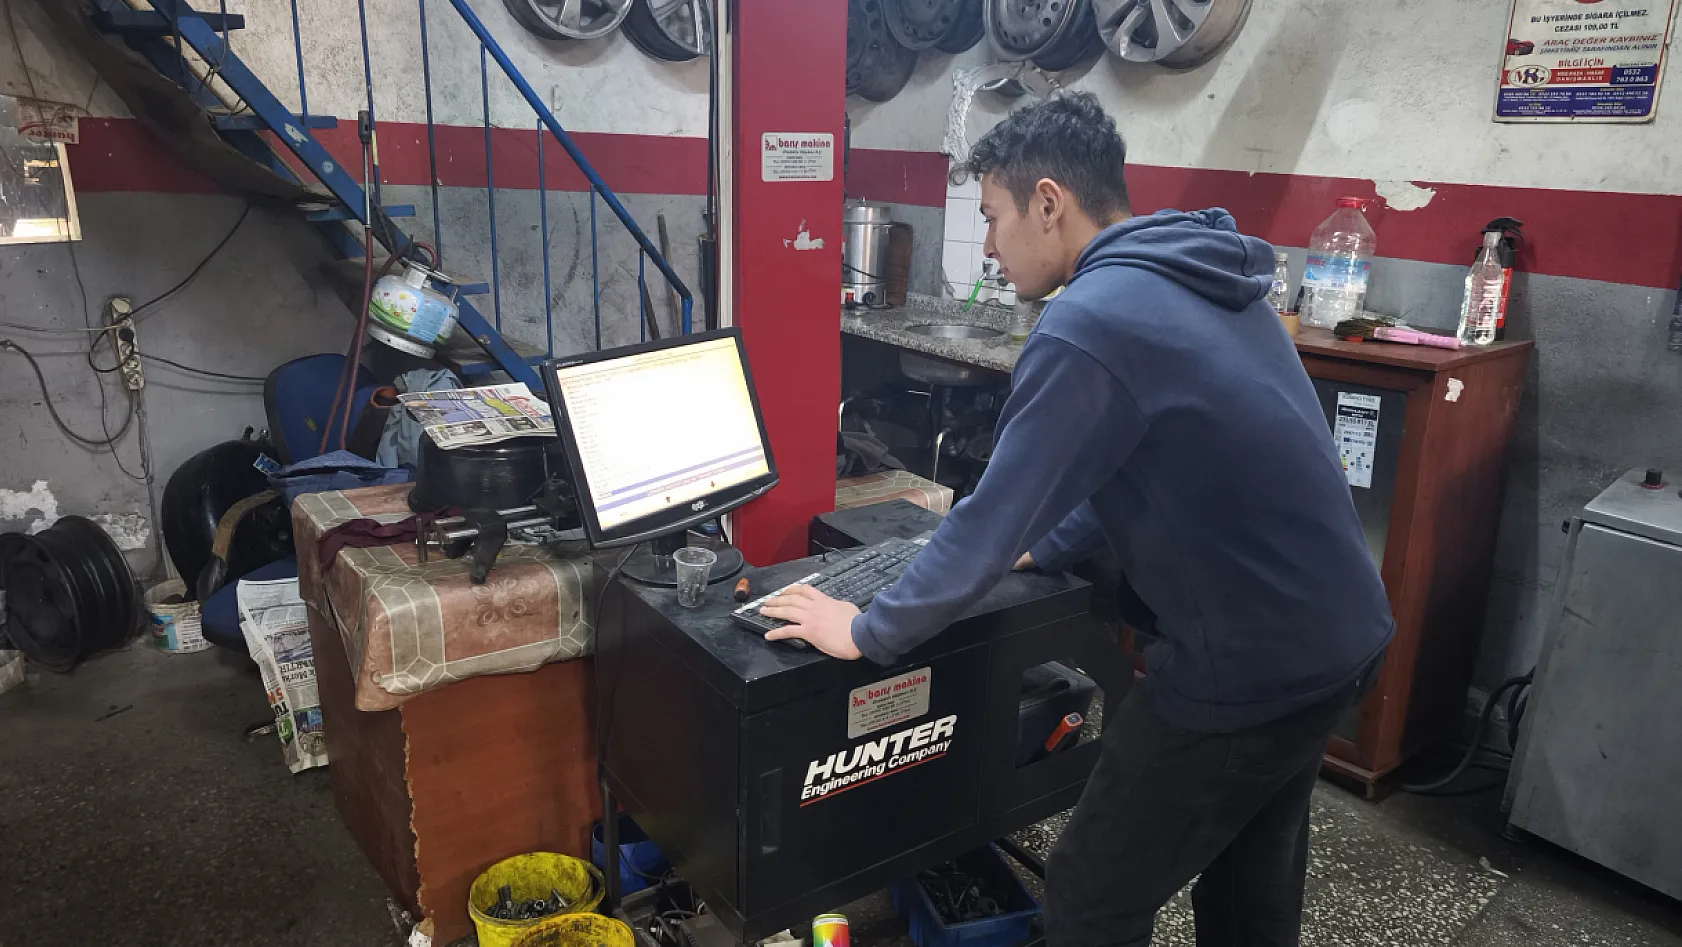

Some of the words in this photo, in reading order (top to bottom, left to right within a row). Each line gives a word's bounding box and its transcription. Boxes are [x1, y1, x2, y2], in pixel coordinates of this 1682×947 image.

[801, 762, 887, 800] Engineering
[888, 740, 952, 768] Company
[804, 714, 957, 786] HUNTER
